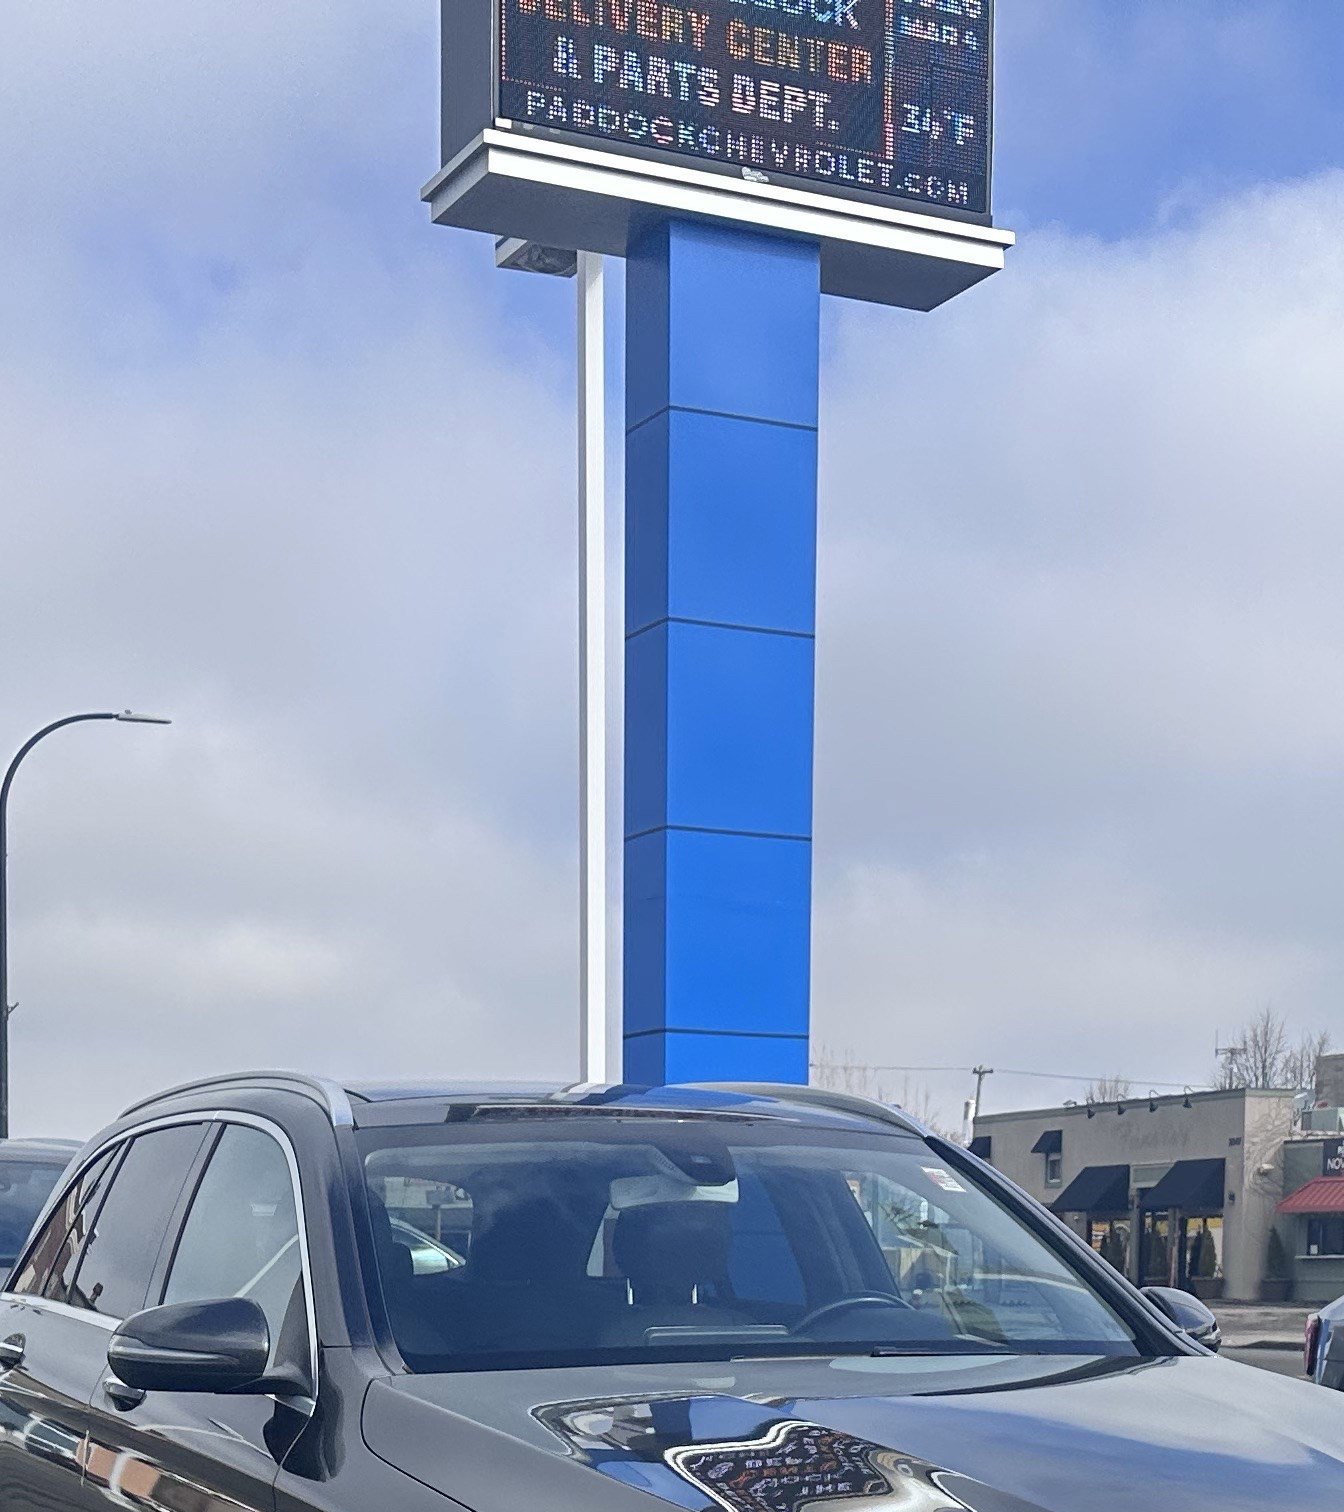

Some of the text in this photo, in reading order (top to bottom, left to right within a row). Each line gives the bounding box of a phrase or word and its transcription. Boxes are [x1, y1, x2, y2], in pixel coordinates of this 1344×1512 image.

[553, 35, 840, 133] & PARTS DEPT.
[726, 18, 872, 84] CENTER
[527, 90, 969, 205] PADDOCKCHEVROLET.COM
